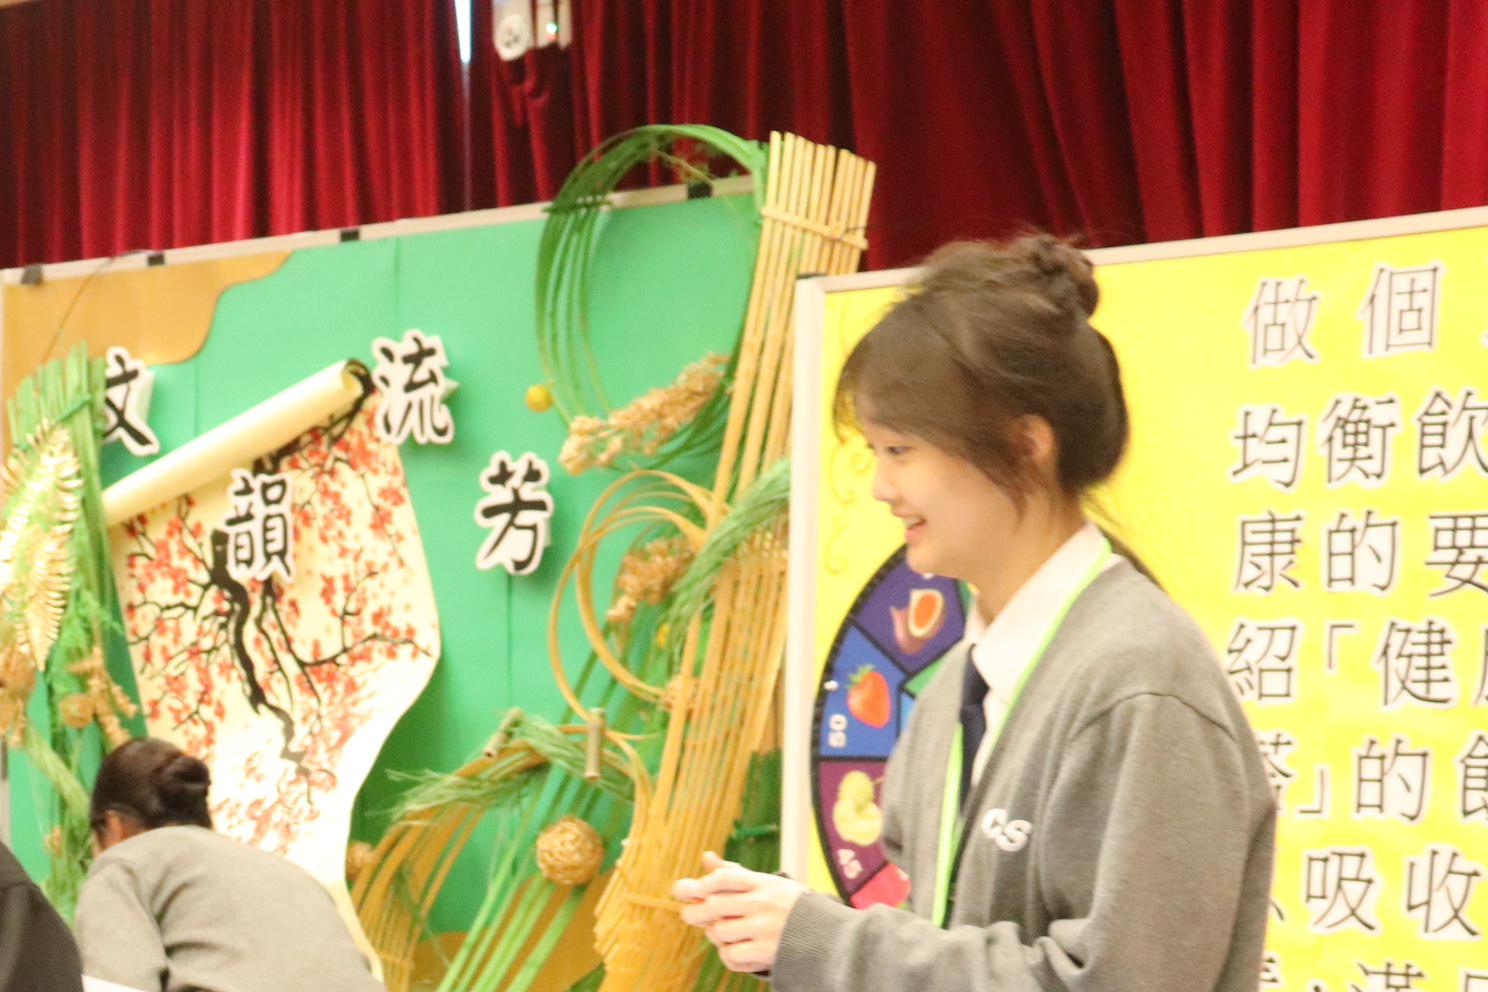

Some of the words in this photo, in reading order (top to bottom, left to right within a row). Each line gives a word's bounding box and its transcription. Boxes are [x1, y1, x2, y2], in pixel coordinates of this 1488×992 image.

[1232, 390, 1488, 488] 均衡飲
[1232, 509, 1488, 597] 康的要
[1226, 619, 1488, 706] 紹「健
[1269, 849, 1481, 938] 吸收
